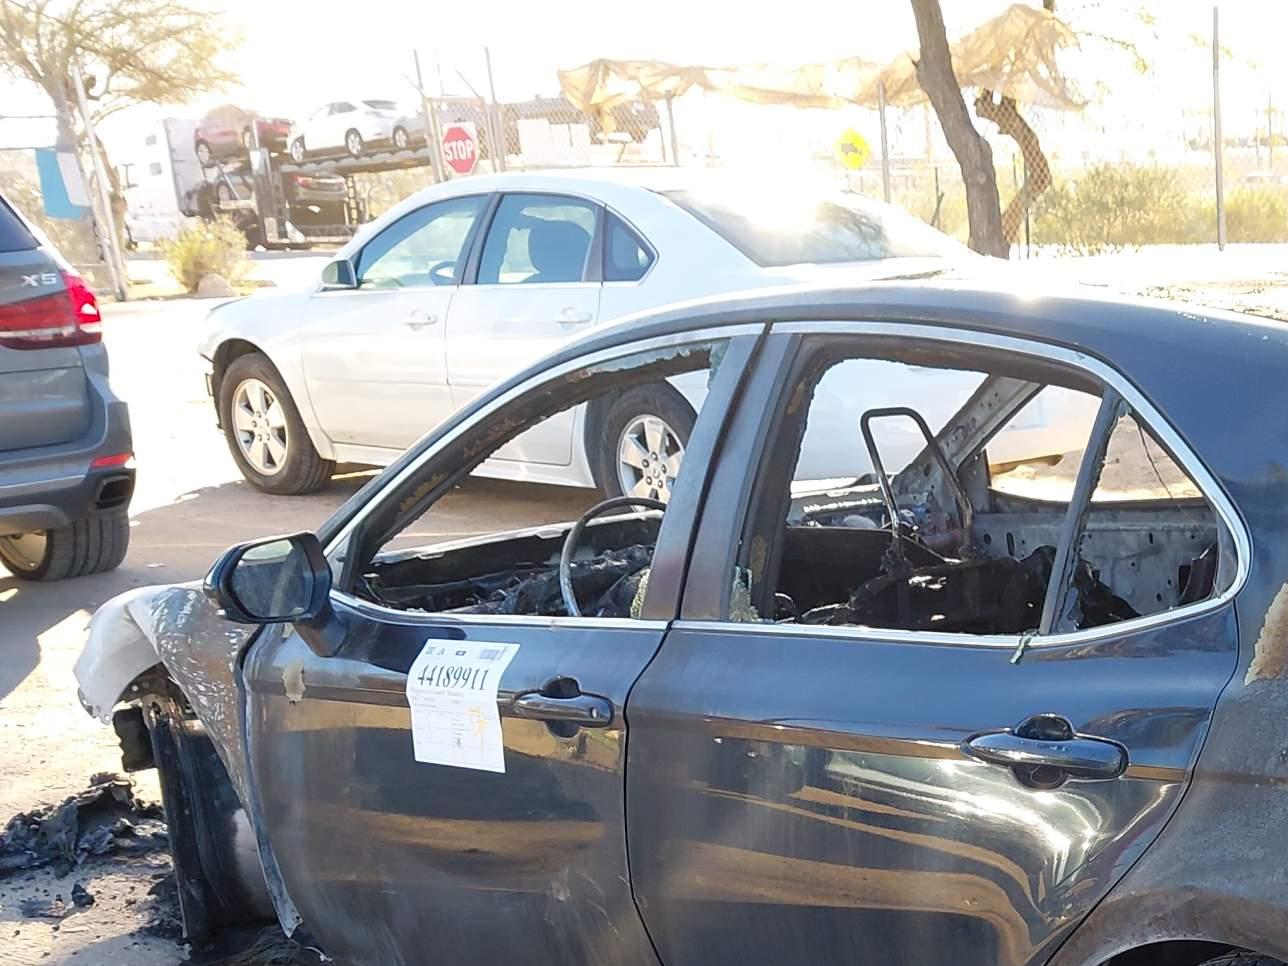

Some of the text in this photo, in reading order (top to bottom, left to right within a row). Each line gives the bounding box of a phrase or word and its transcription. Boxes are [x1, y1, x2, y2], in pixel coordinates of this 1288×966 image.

[444, 139, 473, 161] STOP
[21, 273, 57, 288] X5
[417, 663, 489, 691] 44189911
